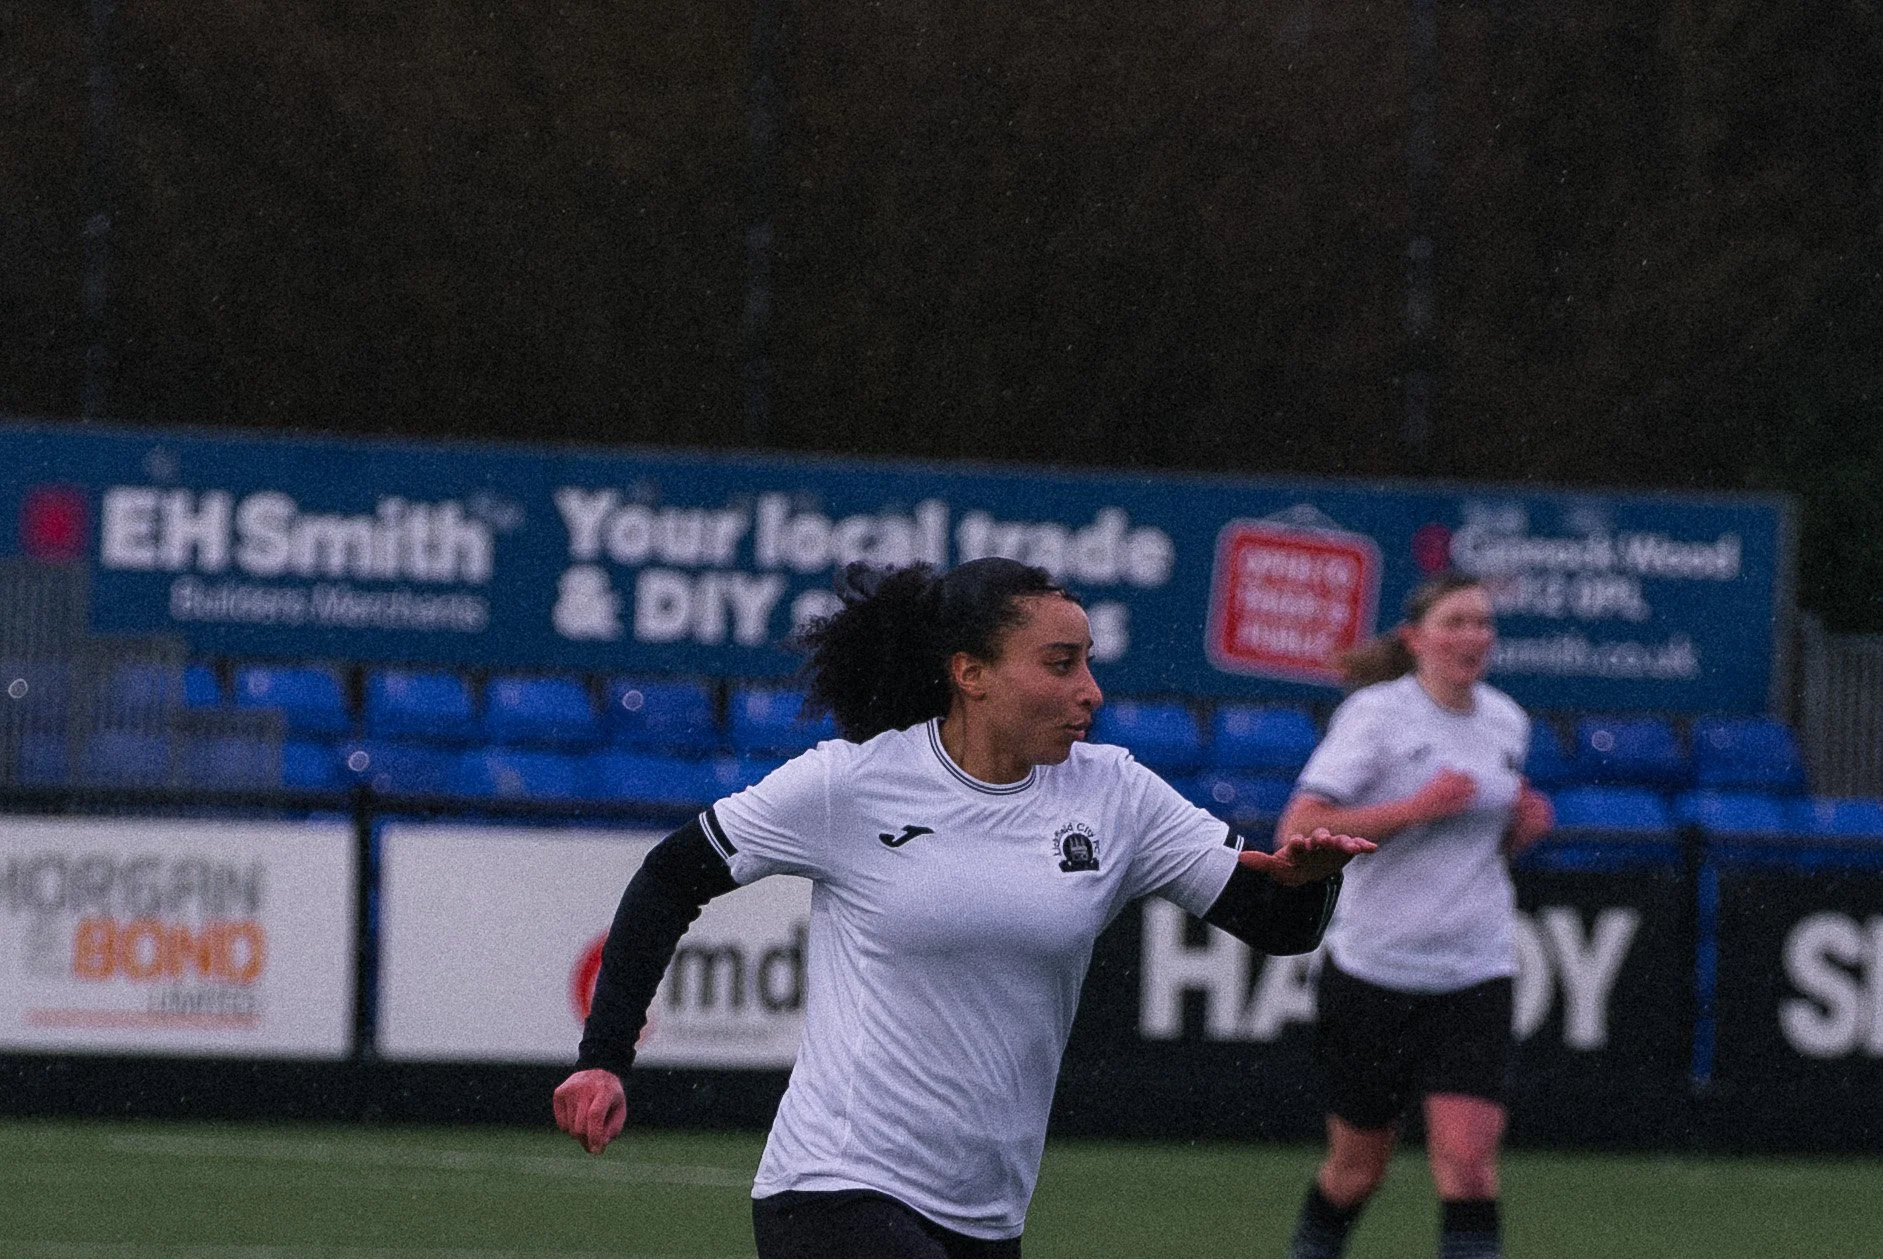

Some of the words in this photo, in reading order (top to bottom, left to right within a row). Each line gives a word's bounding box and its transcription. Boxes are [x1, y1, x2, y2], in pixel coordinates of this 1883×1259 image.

[235, 488, 492, 584] Smith
[556, 486, 748, 565] Your
[755, 492, 952, 572] local
[957, 506, 1176, 588] trade
[552, 562, 622, 642] &
[634, 570, 786, 647] DIY
[72, 917, 267, 985] BOND
[1139, 895, 1641, 1049] HAY
[1779, 912, 1883, 1057] S
